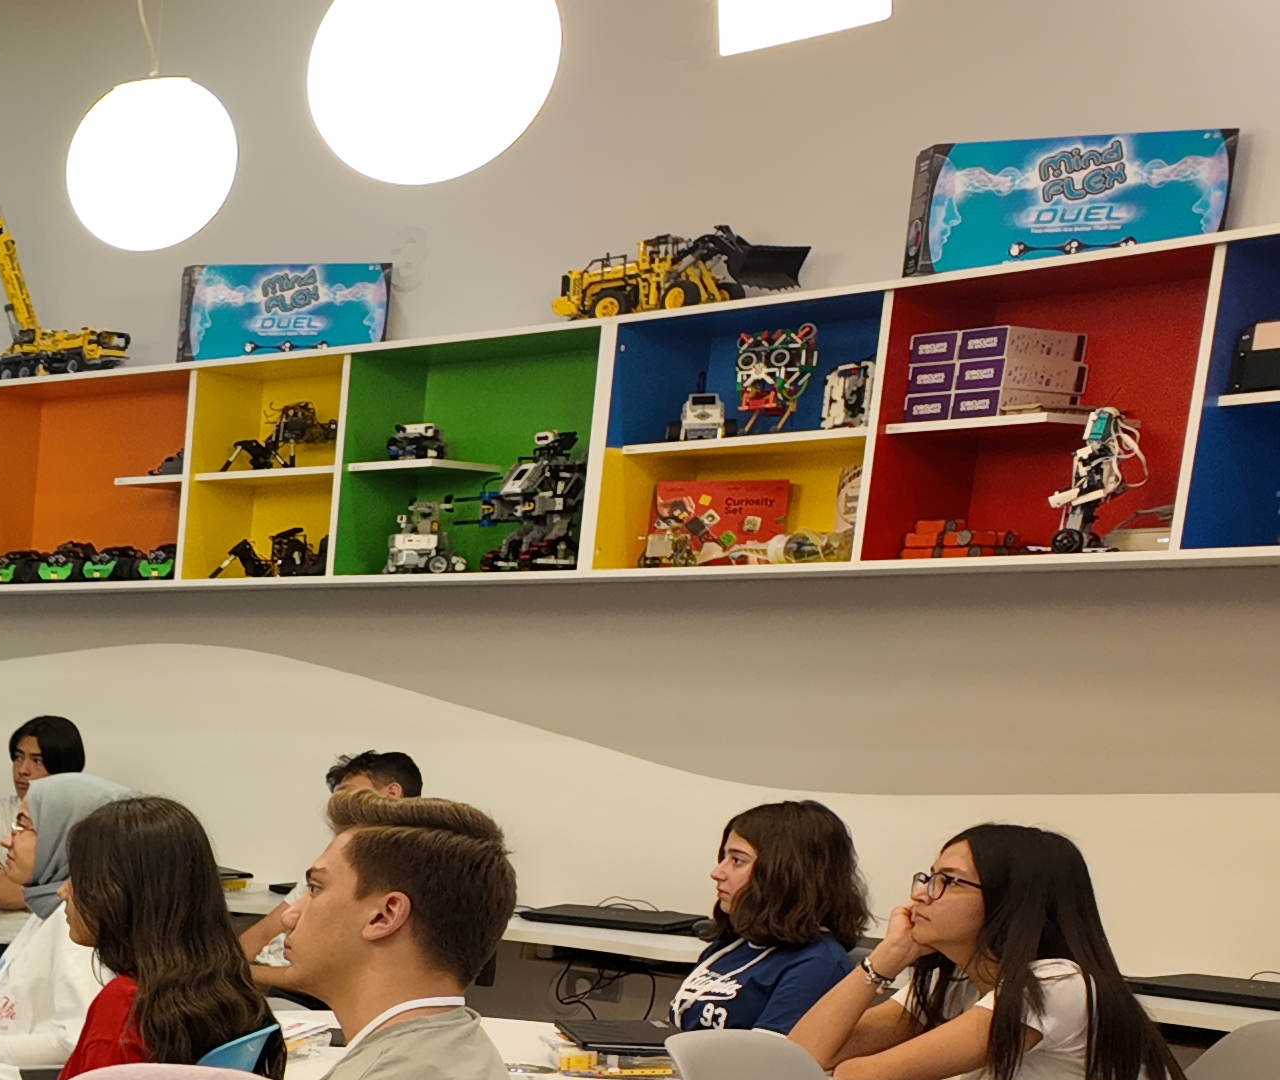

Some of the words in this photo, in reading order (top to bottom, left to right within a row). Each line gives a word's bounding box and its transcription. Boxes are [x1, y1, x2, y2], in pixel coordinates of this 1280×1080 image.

[1034, 204, 1123, 225] DUEL
[259, 316, 319, 330] DUEL
[700, 1002, 728, 1030] 93
